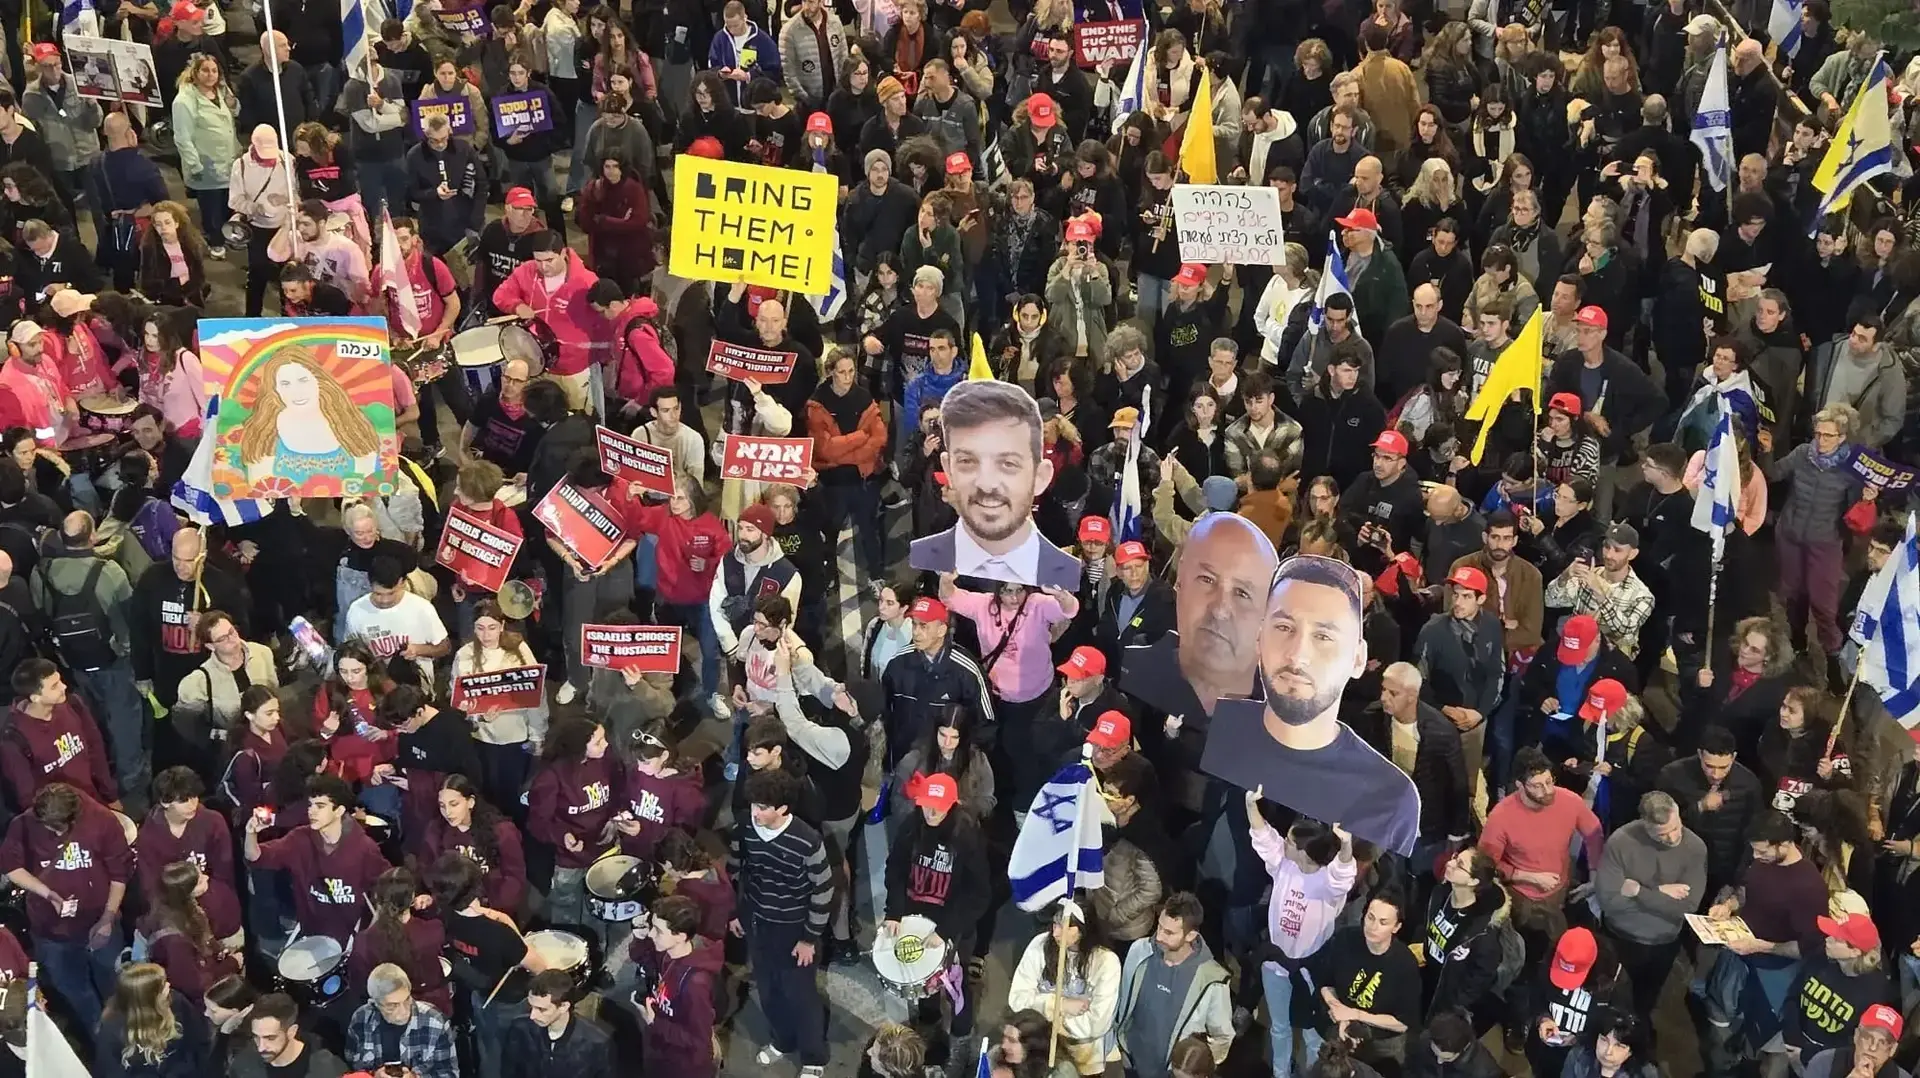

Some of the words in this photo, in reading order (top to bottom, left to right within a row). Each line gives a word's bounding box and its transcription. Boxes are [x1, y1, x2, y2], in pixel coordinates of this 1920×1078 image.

[1080, 27, 1107, 36] END
[1108, 24, 1137, 34] THIS
[1082, 45, 1137, 62] WAR
[696, 172, 812, 211] BRING
[1192, 191, 1222, 206] היה
[1225, 192, 1252, 209] זה
[694, 208, 794, 245] THEM
[1237, 210, 1268, 228] אצלי
[1179, 225, 1215, 244] לעשות
[1218, 229, 1248, 246] רציתי
[1254, 229, 1278, 246] ולא
[695, 243, 812, 287] HOME!
[341, 343, 380, 357] נעמה
[600, 434, 634, 455] ISRAELIS
[635, 447, 669, 465] CHOOSE
[736, 441, 804, 464] אמא
[605, 448, 621, 462] THE
[621, 455, 666, 477] HOSTAGES!
[752, 461, 802, 478] כאן
[1852, 460, 1890, 486] שלום
[558, 483, 590, 513] תקווה
[448, 516, 481, 540] ISRAELIS
[481, 532, 516, 556] CHOOSE
[447, 533, 462, 549] THE
[460, 540, 507, 569] HOSTAGES!
[586, 631, 632, 642] ISRAELIS
[634, 632, 677, 642] CHOOSE
[591, 643, 612, 654] THE
[613, 642, 670, 656] HOSTAGES!
[1803, 975, 1854, 1022] הדחה
[1800, 993, 1845, 1033] עכשיו
